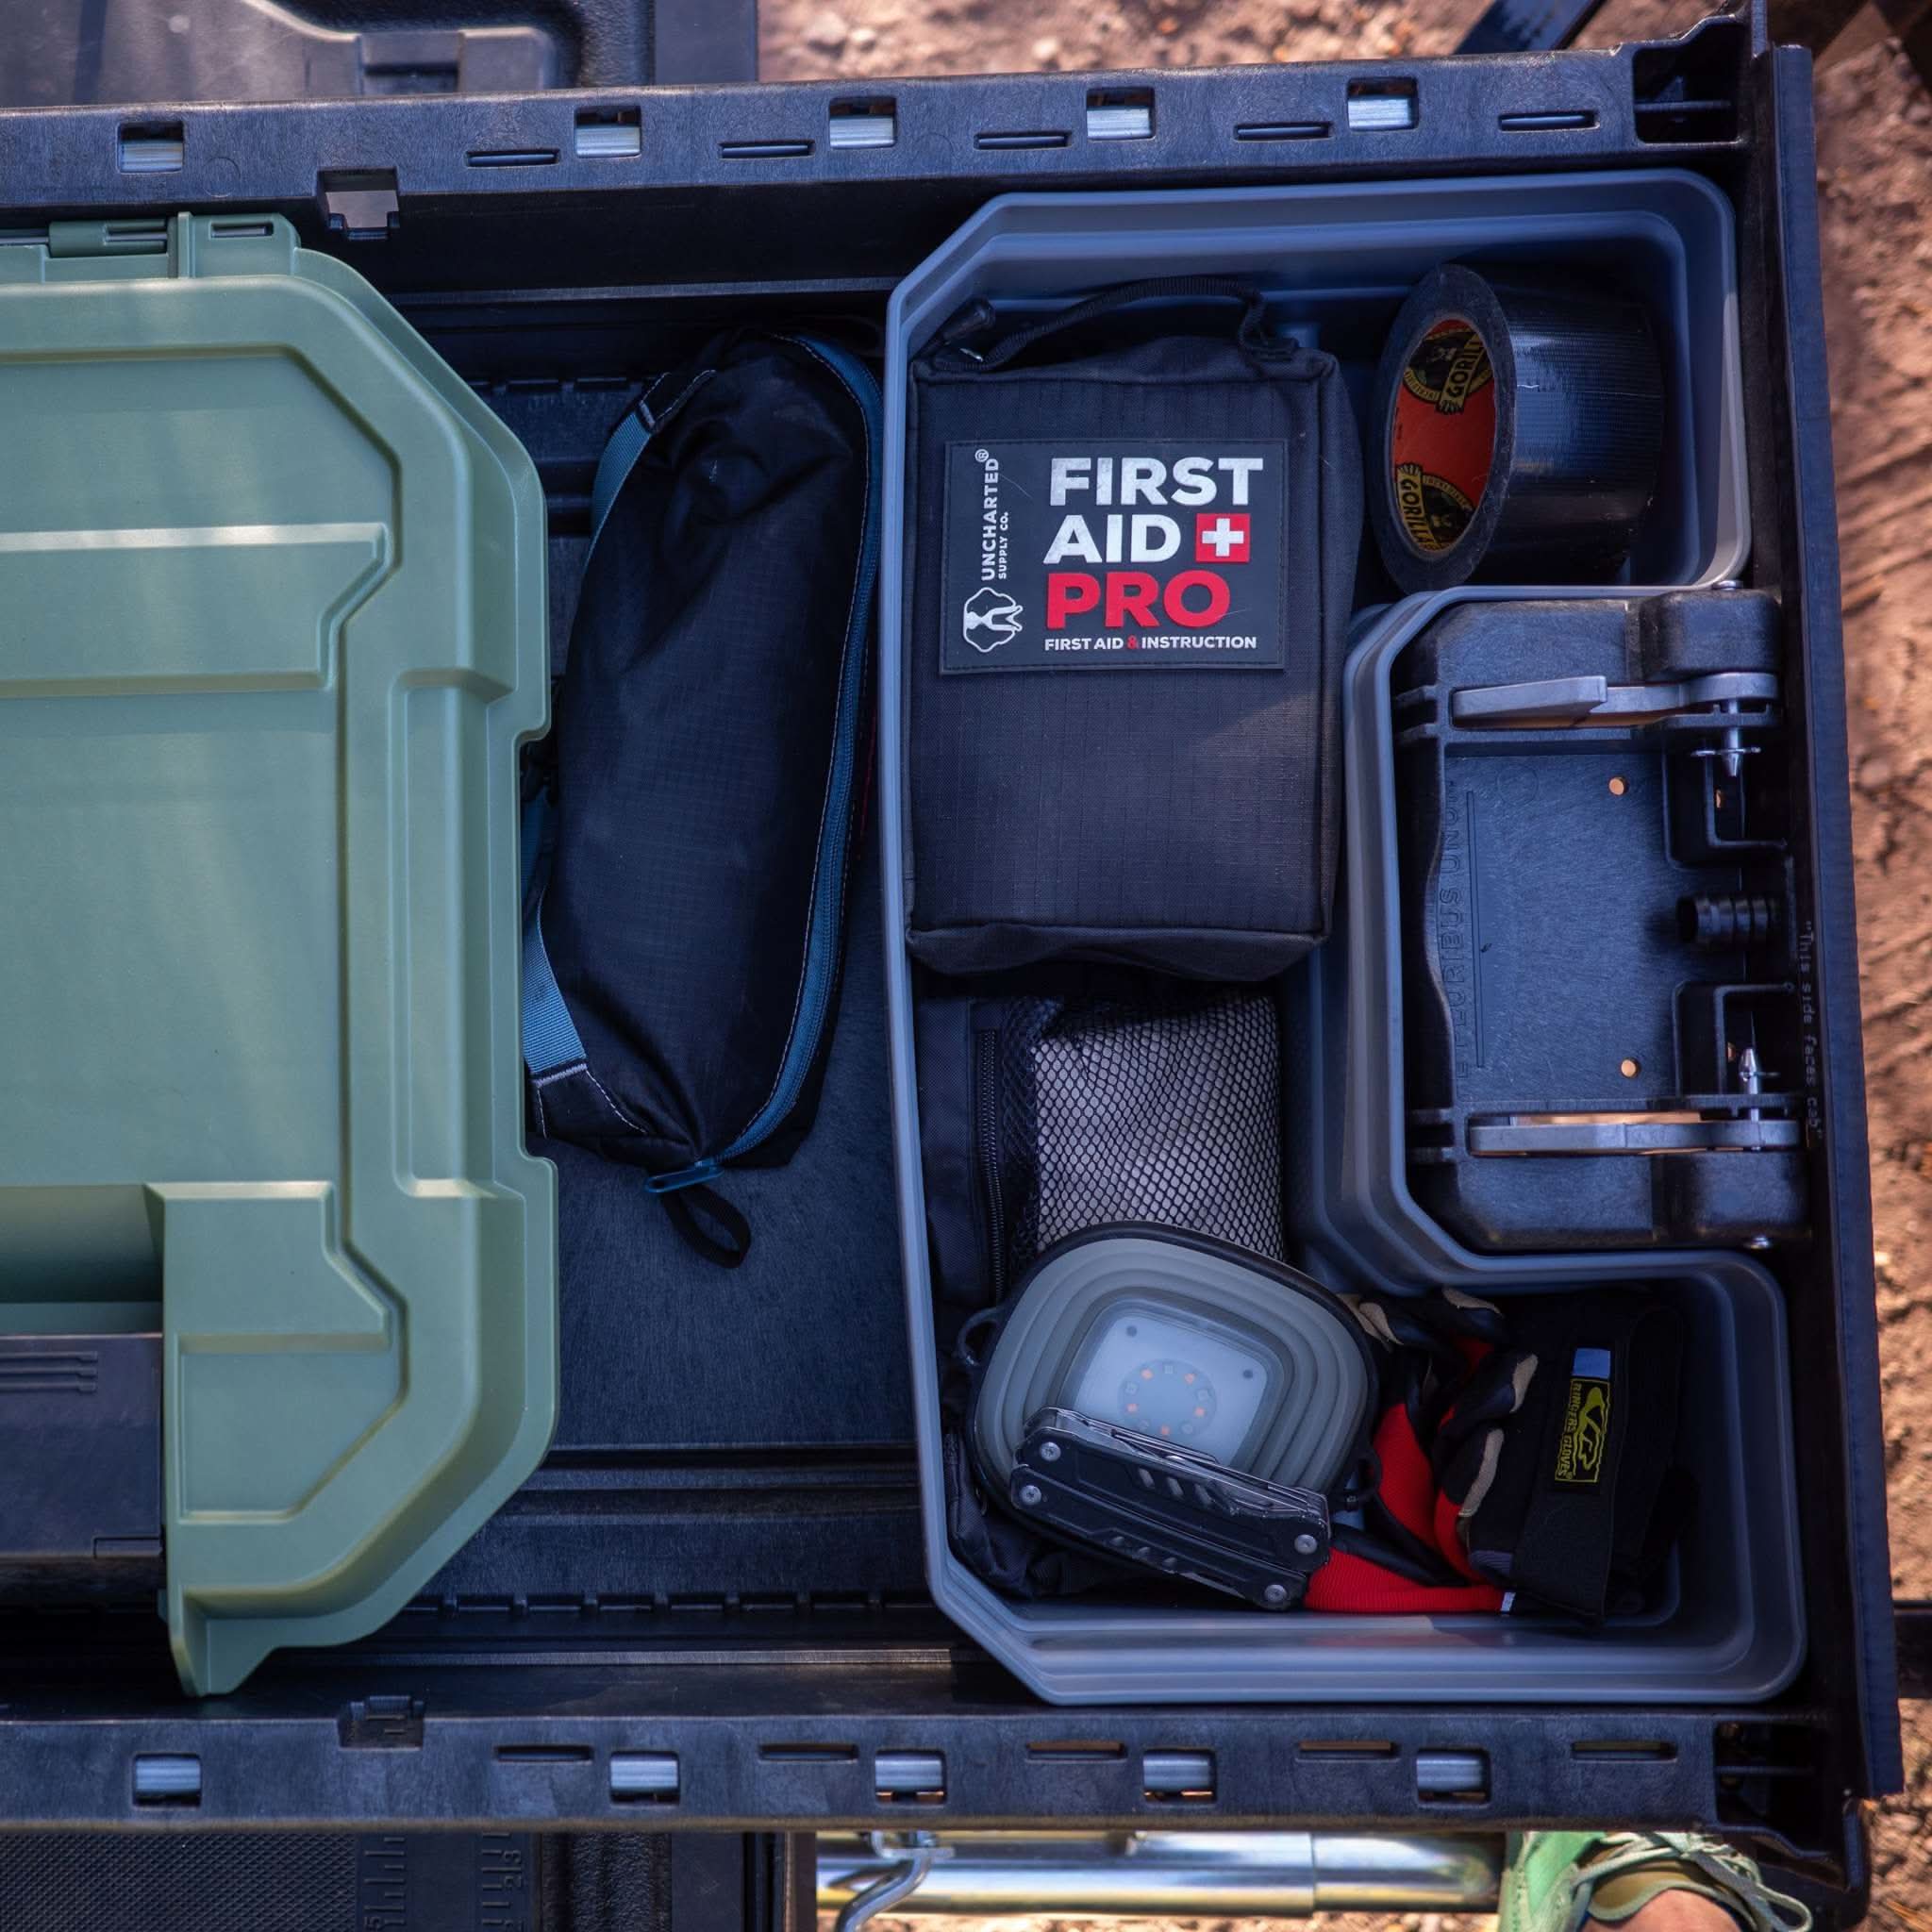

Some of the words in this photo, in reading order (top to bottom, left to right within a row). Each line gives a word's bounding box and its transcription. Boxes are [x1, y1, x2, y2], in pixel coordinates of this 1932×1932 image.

[1050, 457, 1263, 507] FIRST
[1000, 512, 1009, 532] CO.
[1042, 514, 1181, 564] AID
[998, 535, 1008, 579] SUPPLY
[1046, 570, 1231, 629] PRO
[1044, 638, 1092, 651] FIRST
[1093, 637, 1124, 650] AID
[1126, 635, 1138, 649] &
[1141, 636, 1257, 649] INSTRUCTION
[1801, 981, 1815, 1024] side
[1803, 1034, 1819, 1086] faces
[1567, 1383, 1582, 1432] RINGERS
